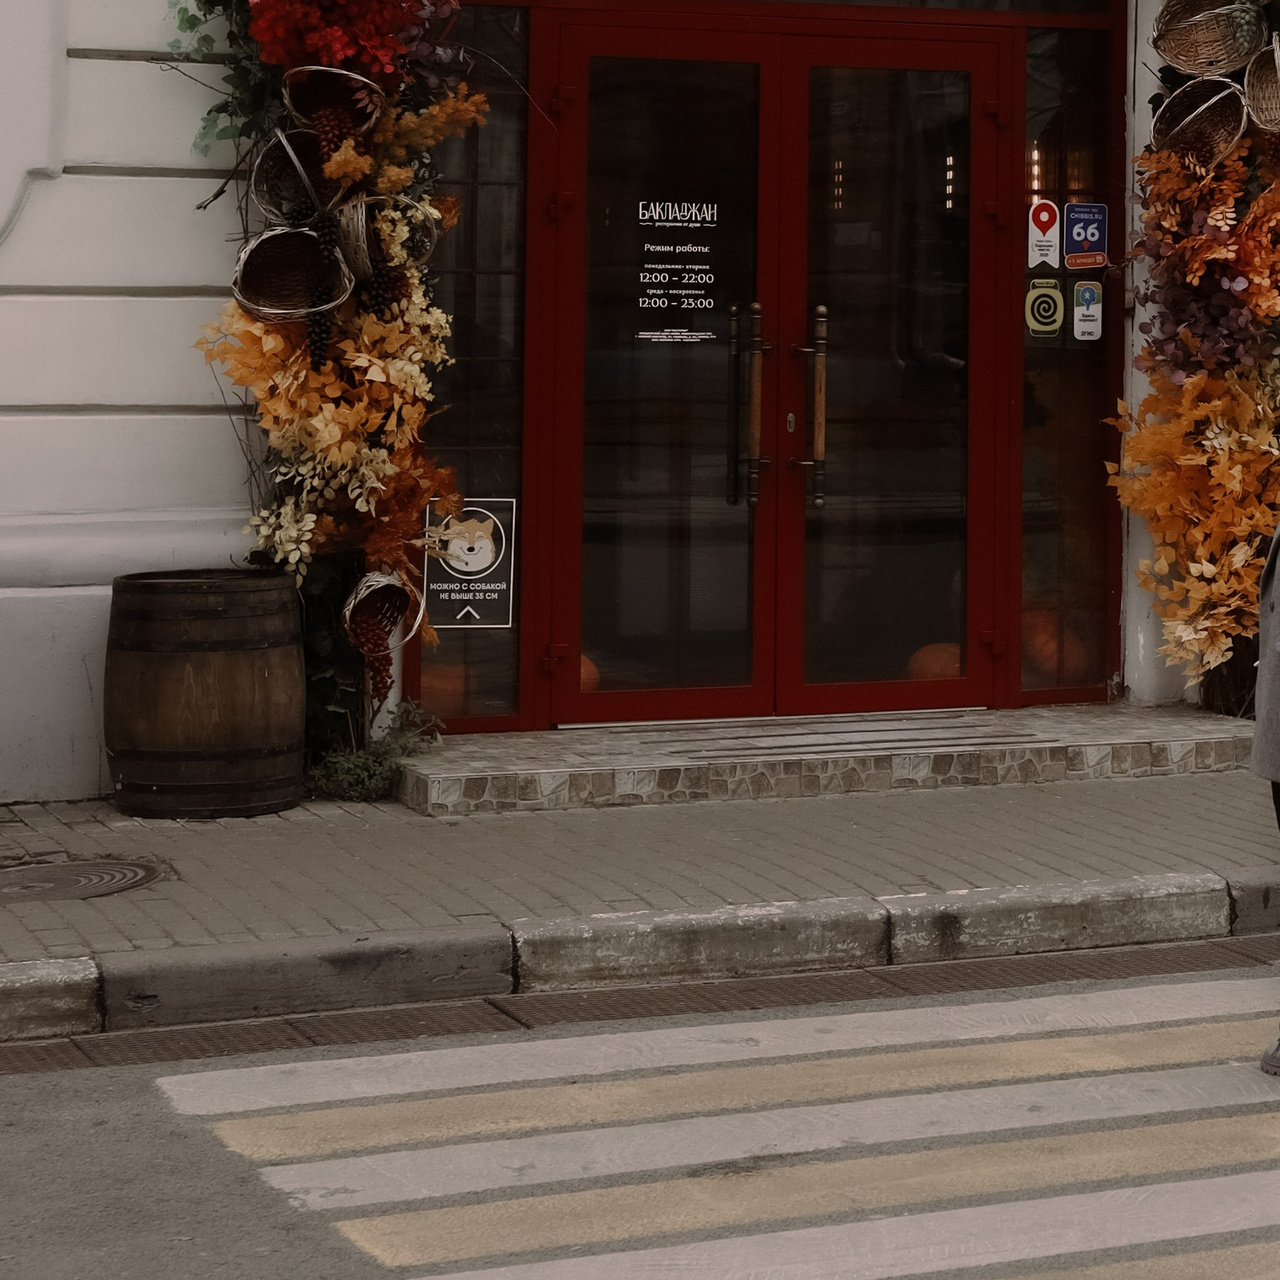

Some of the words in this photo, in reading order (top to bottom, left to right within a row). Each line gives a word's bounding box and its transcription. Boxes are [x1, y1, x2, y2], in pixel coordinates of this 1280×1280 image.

[638, 201, 718, 221] БАКЛАДЖАН
[1069, 212, 1103, 220] CHIBBIS.RU
[644, 243, 673, 252] Режим
[675, 244, 710, 254] работы:
[639, 272, 669, 283] 12:00
[681, 273, 714, 284] 22:00
[638, 297, 668, 308] 12:00
[680, 298, 714, 309] 23:00
[469, 581, 507, 590] СОБАКОЙ
[440, 592, 449, 600] НЕ
[450, 592, 474, 600] ВЫШЕ
[475, 592, 485, 600] 35
[485, 592, 498, 600] СМ
